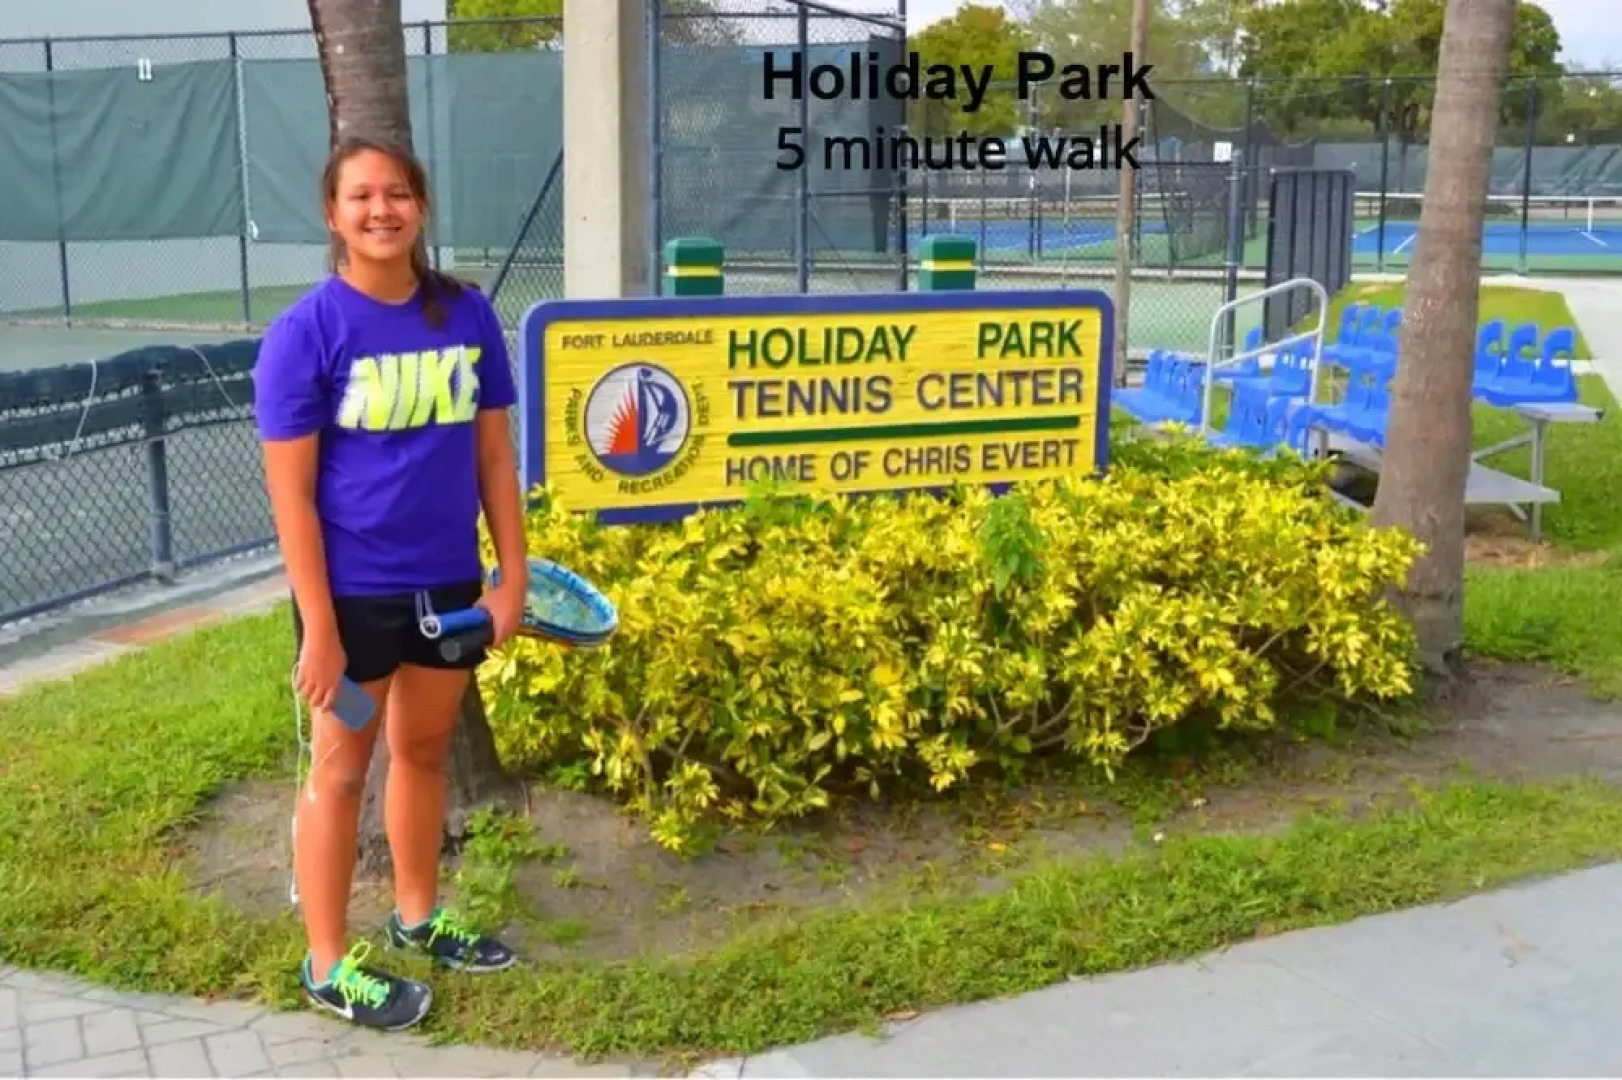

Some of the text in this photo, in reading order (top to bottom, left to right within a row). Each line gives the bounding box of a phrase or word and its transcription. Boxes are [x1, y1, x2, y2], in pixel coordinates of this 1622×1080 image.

[561, 329, 714, 350] FORT LAUDERDALE
[728, 320, 1083, 369] HOLIDAY PARK
[336, 345, 482, 431] NIKE
[728, 368, 1084, 419] TENNIS CENTER
[725, 438, 1080, 488] HOME OF CHRIS EVERT
